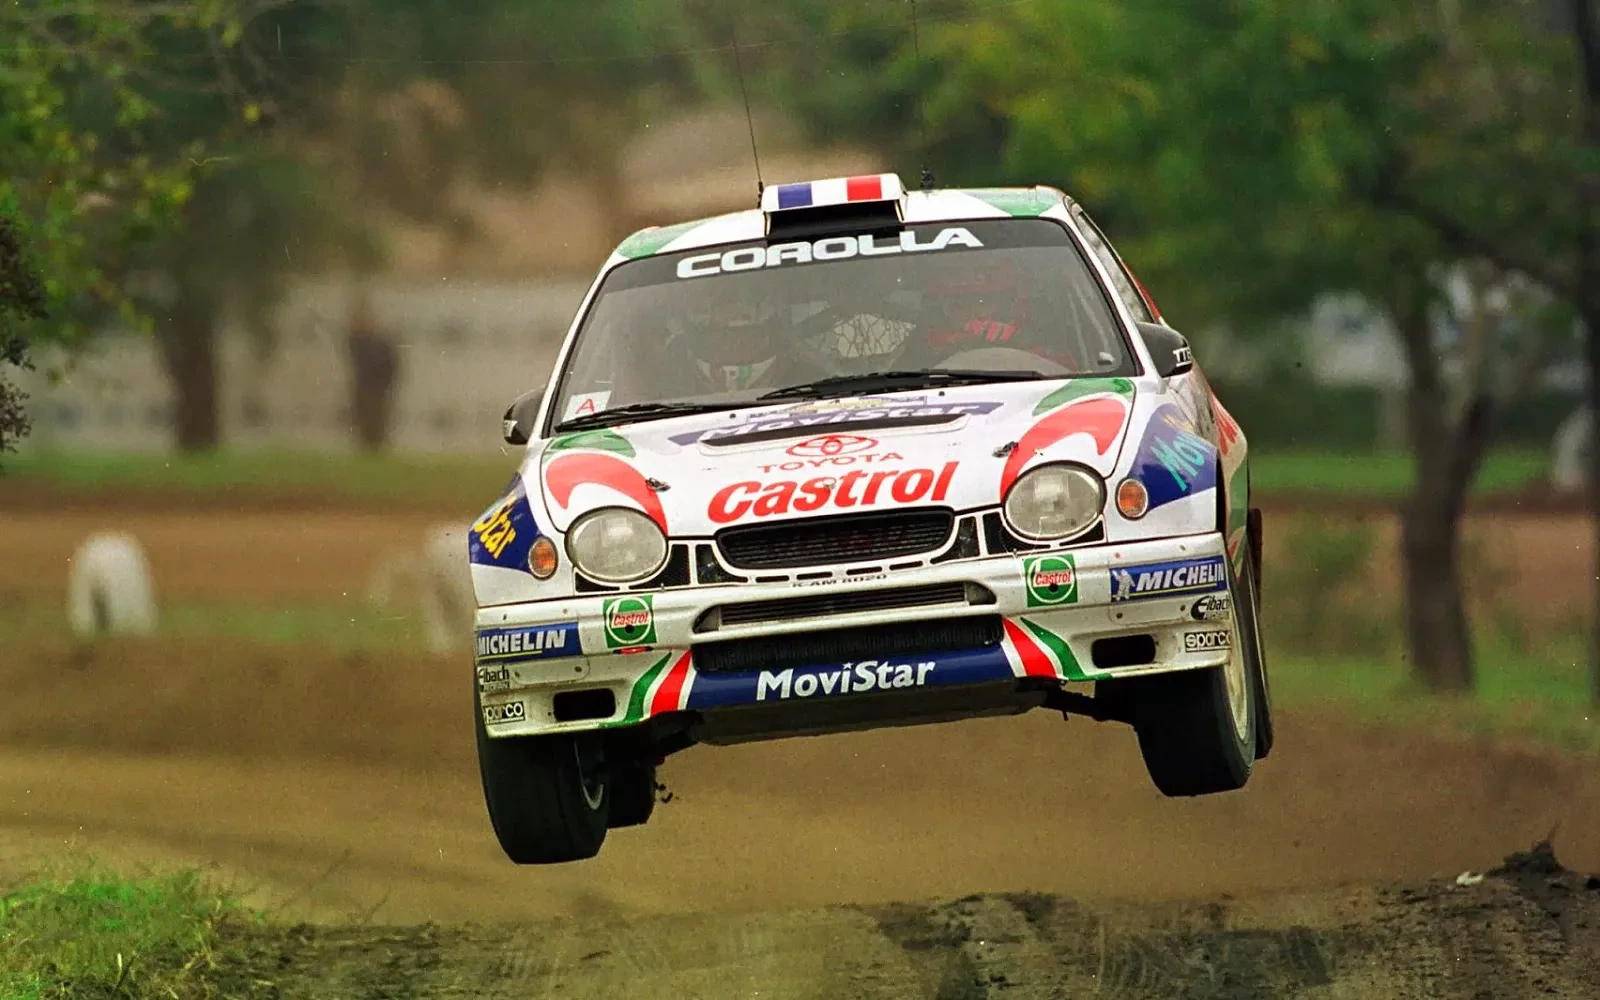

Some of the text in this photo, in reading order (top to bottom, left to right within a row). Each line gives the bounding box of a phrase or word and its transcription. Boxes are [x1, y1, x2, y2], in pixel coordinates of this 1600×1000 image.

[676, 227, 985, 278] COROLLA
[575, 398, 595, 414] A
[758, 452, 904, 473] TOYOTA
[707, 461, 960, 523] Castrol
[1034, 570, 1072, 586] Castrol
[1136, 563, 1225, 592] MICHELIN
[612, 611, 650, 627] Castrol
[756, 660, 936, 701] MoviStar
[481, 702, 524, 724] parco
